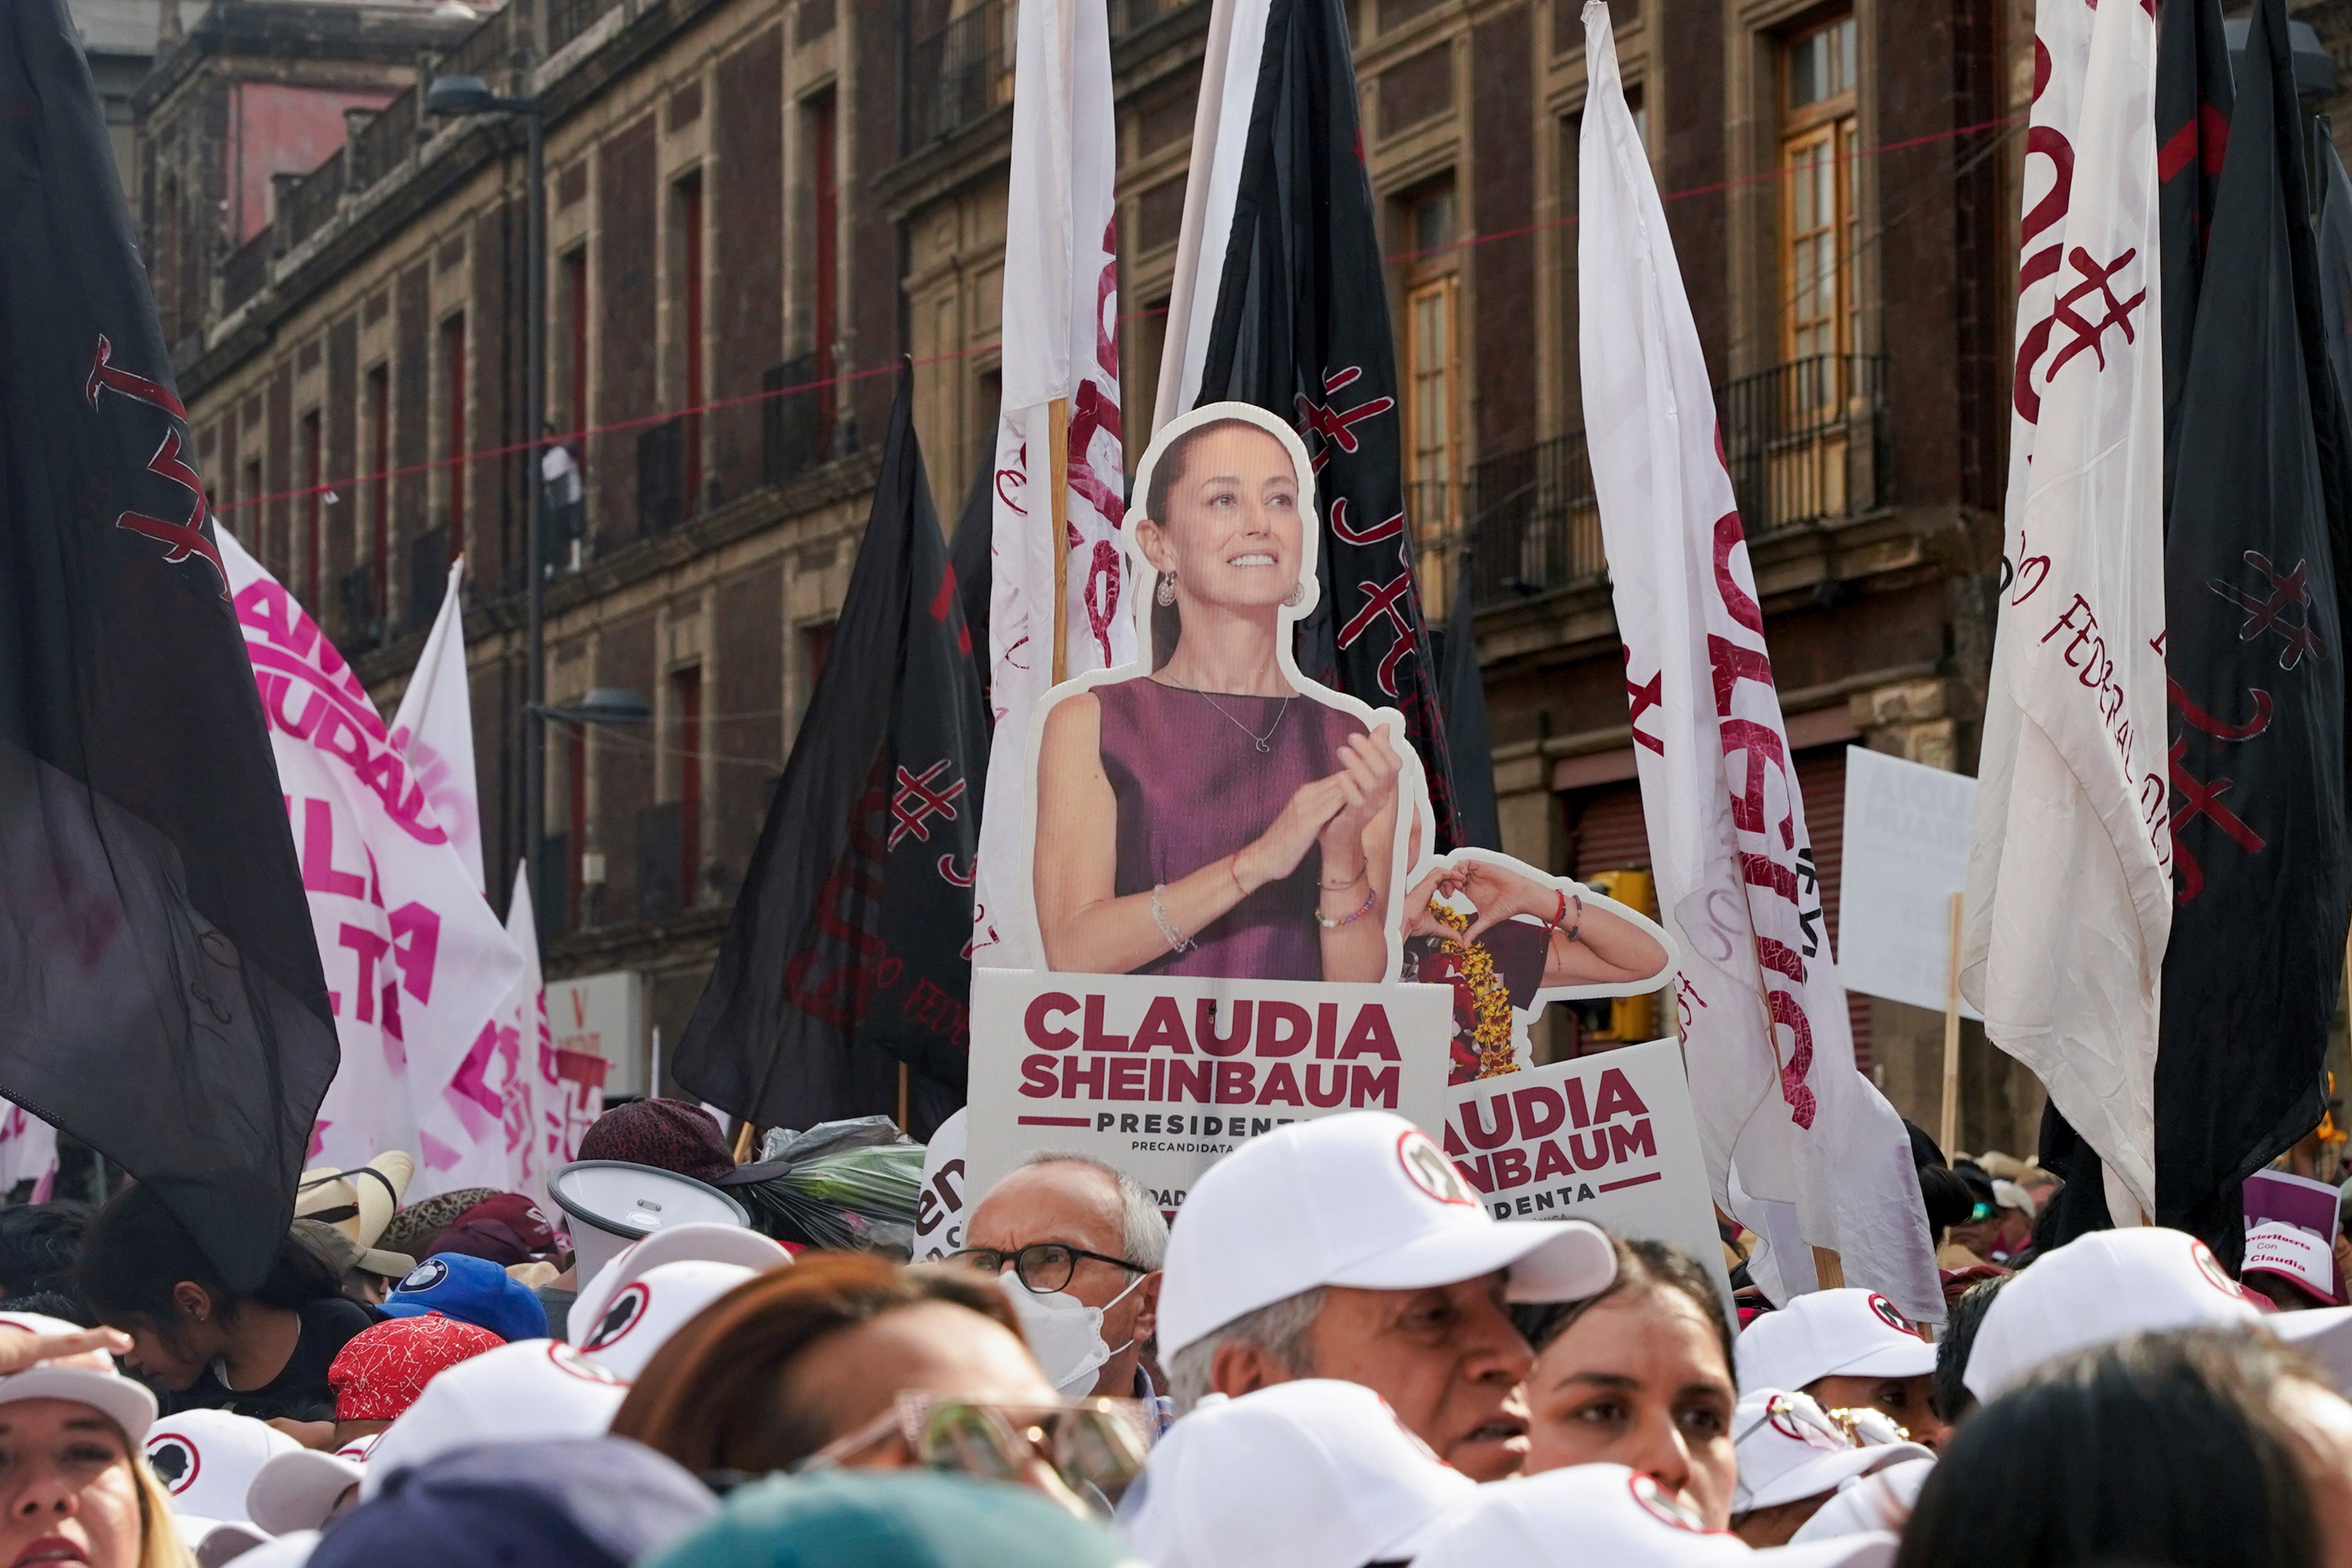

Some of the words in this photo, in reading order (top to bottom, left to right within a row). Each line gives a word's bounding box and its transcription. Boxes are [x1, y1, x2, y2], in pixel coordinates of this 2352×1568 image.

[1024, 991, 1402, 1062] CLAUDIA
[1017, 1053, 1400, 1109] SHEINBAUM
[1097, 1112, 1310, 1136] PRESIDEN
[1443, 1067, 1650, 1157] UDIA
[1132, 1141, 1233, 1153] PRECANDIDATA
[1451, 1117, 1658, 1194] NBAUM
[1485, 1182, 1596, 1220] DENTA
[2250, 1254, 2306, 1273] Claudia
[2257, 1242, 2278, 1250] Con
